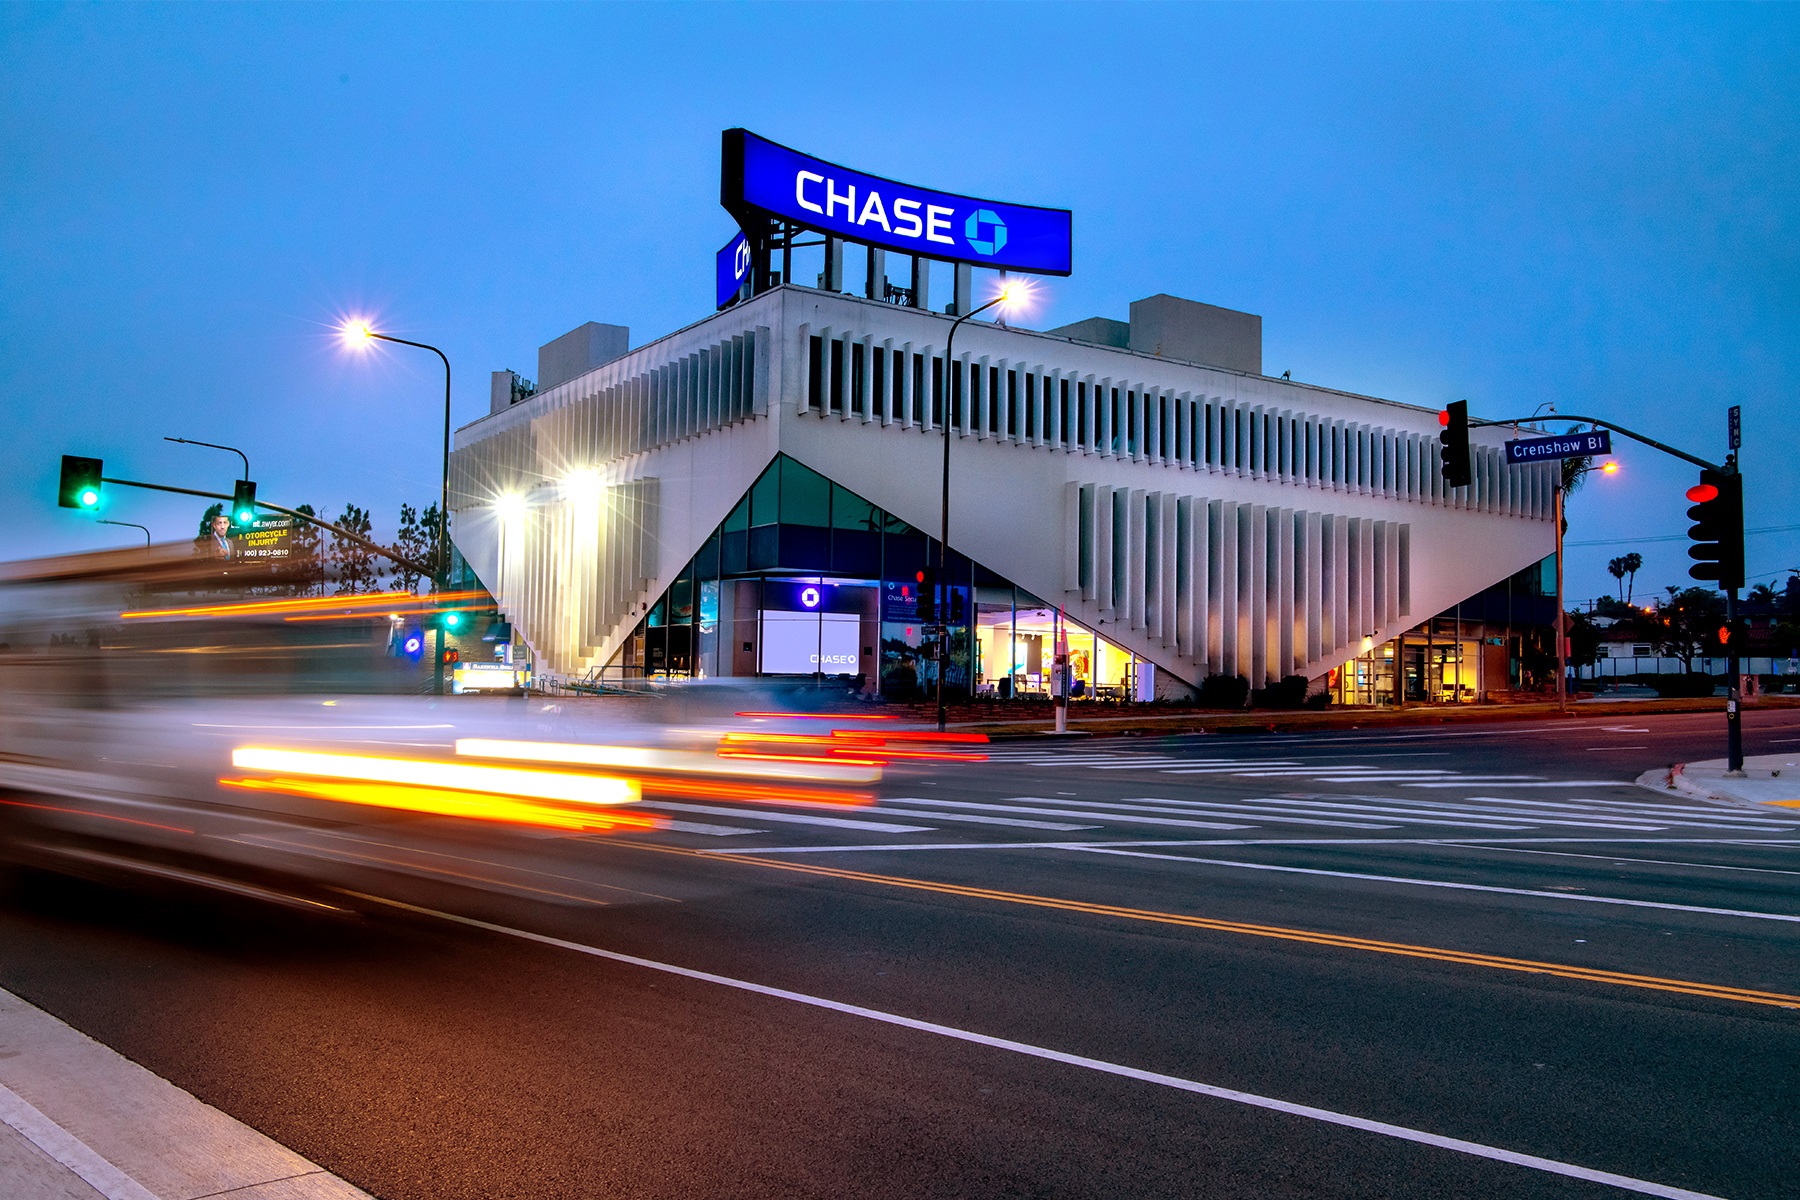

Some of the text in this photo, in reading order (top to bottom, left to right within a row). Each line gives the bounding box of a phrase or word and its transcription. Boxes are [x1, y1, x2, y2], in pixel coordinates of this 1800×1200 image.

[796, 170, 955, 245] CHASE
[1513, 441, 1581, 457] Crenshaw
[248, 537, 279, 547] INJURY?
[887, 594, 904, 602] Chase
[810, 654, 847, 664] CHASE
